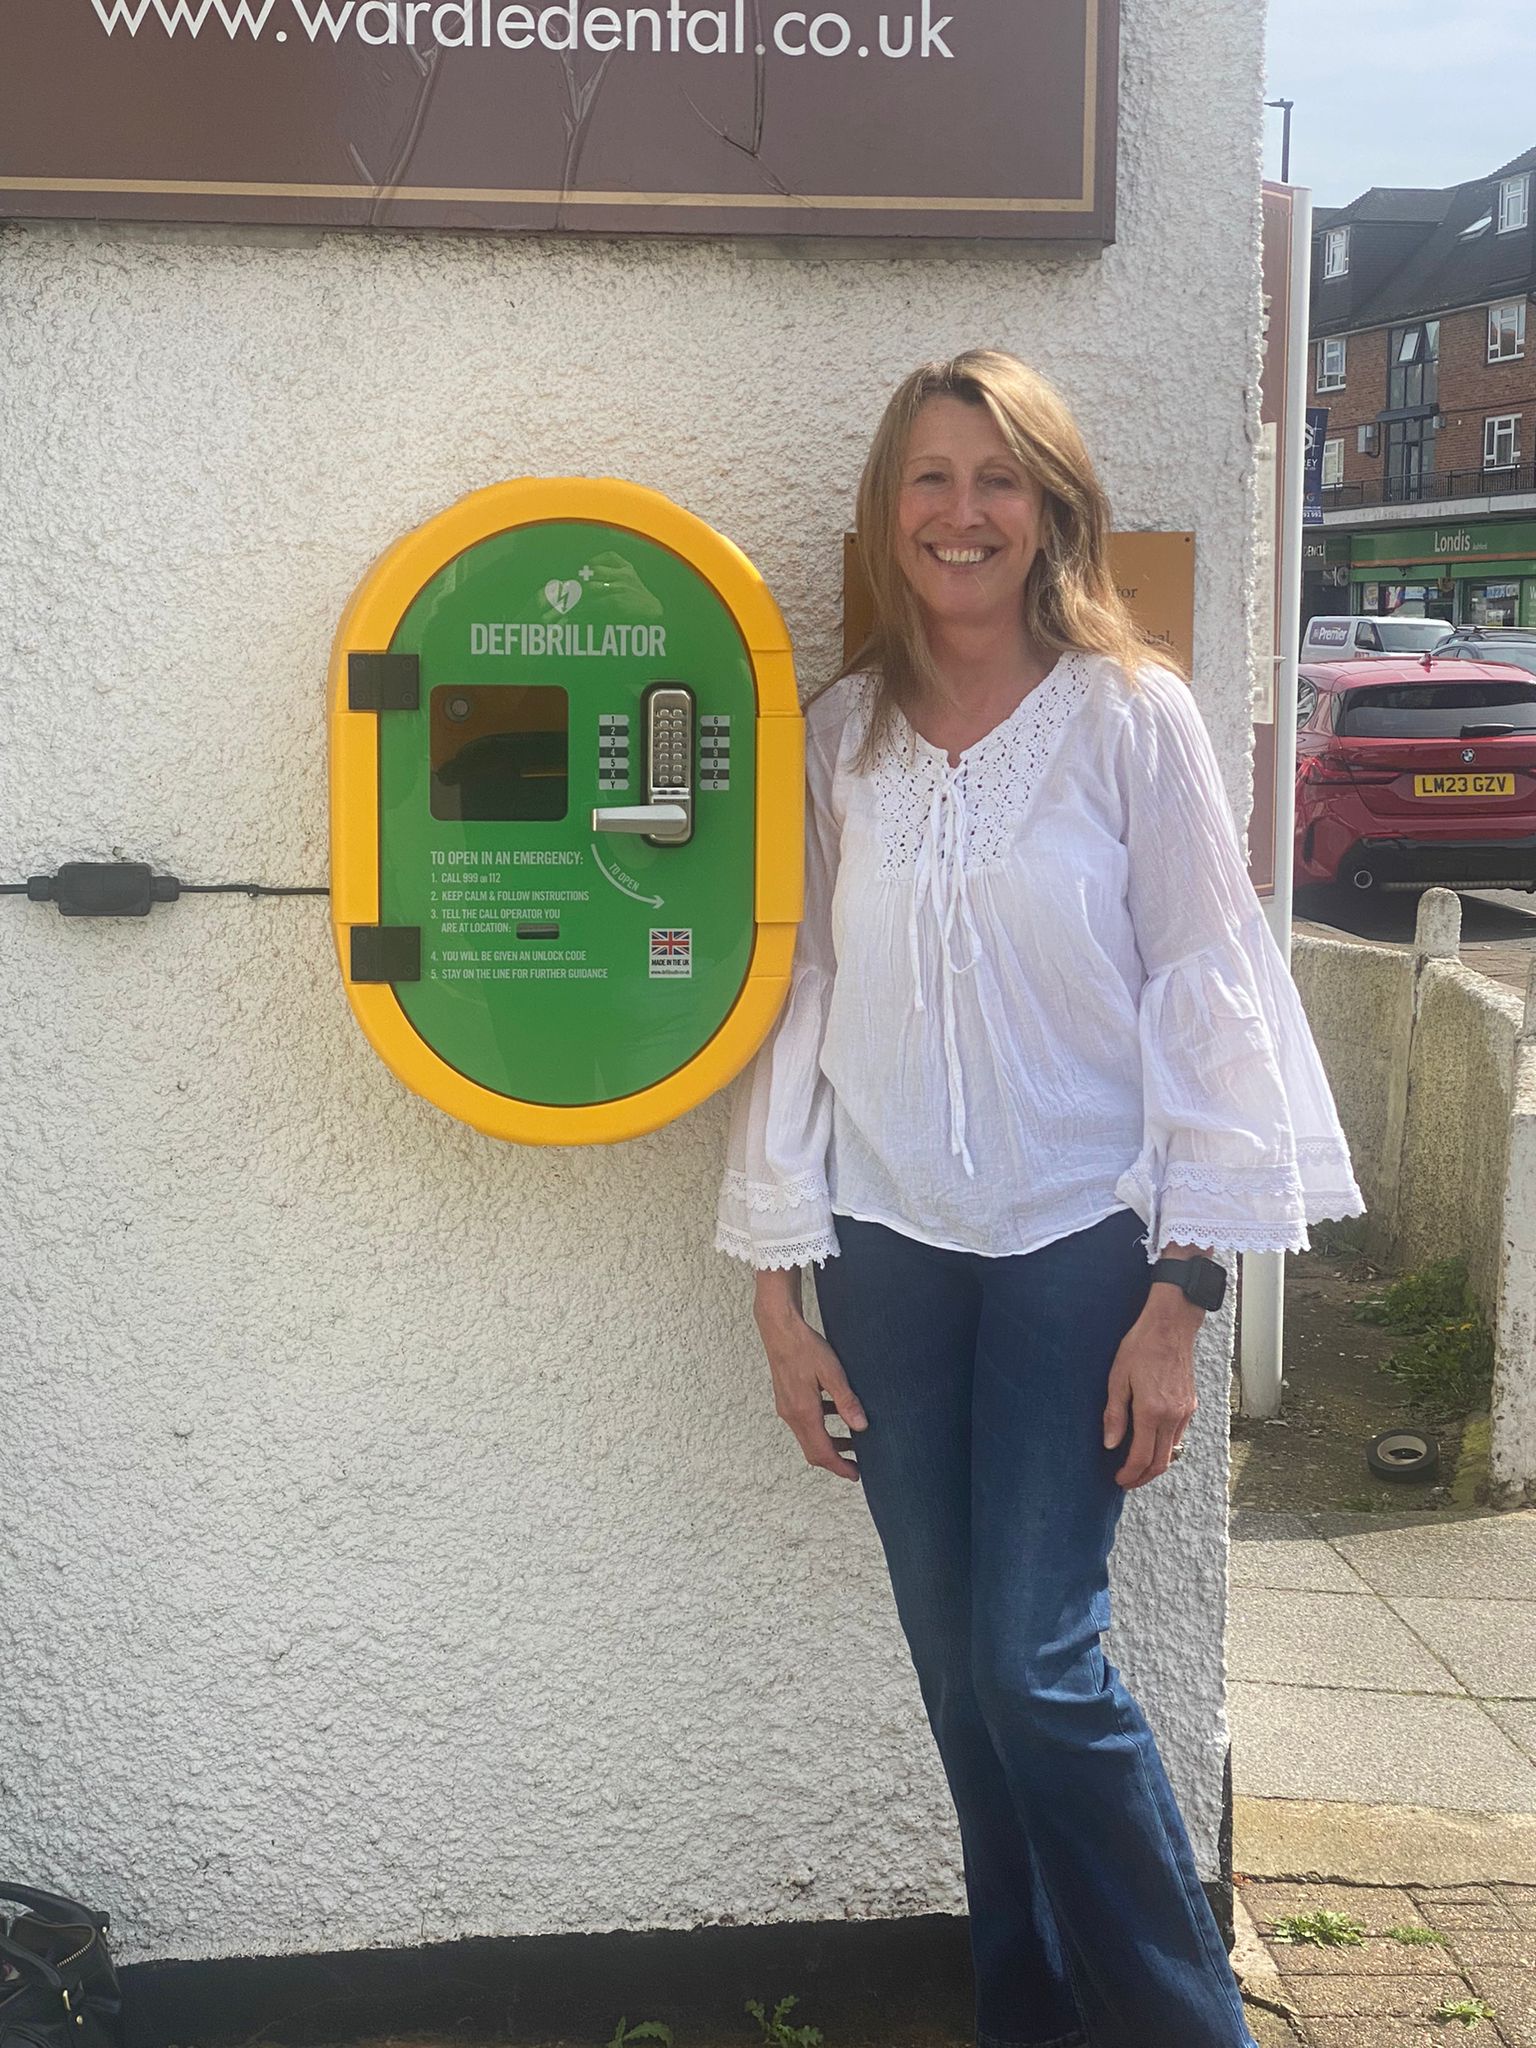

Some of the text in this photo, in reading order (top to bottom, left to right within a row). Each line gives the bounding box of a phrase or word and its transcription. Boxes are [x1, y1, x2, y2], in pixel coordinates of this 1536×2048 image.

[91, 0, 955, 59] www.wardledental.co.uk
[1304, 459, 1318, 467] EY
[1434, 530, 1471, 552] Londis
[471, 623, 667, 656] DEFIBRILLATOR
[1422, 776, 1506, 793] LM23 GZV
[430, 851, 584, 865] TO OPEN IN AN EMERGENCY:
[431, 872, 438, 883] 1.
[441, 872, 461, 883] CALL
[462, 872, 478, 883] 999
[488, 872, 501, 883] 112
[608, 863, 640, 892] TO OPEN
[430, 891, 590, 902] 2. KEEP CALM & FOLLOW INSTRUCTIONS
[430, 909, 561, 920] 3. TELL THE CALL OPERATOR YOU
[441, 923, 512, 933] ARE AT LOCATION:
[430, 951, 587, 961] 4. YOU WILL BE GIVEN AN UNLOCK CODE
[430, 969, 609, 979] 5. STAY ON THE LINE FOR FURTHER GUIDANCE
